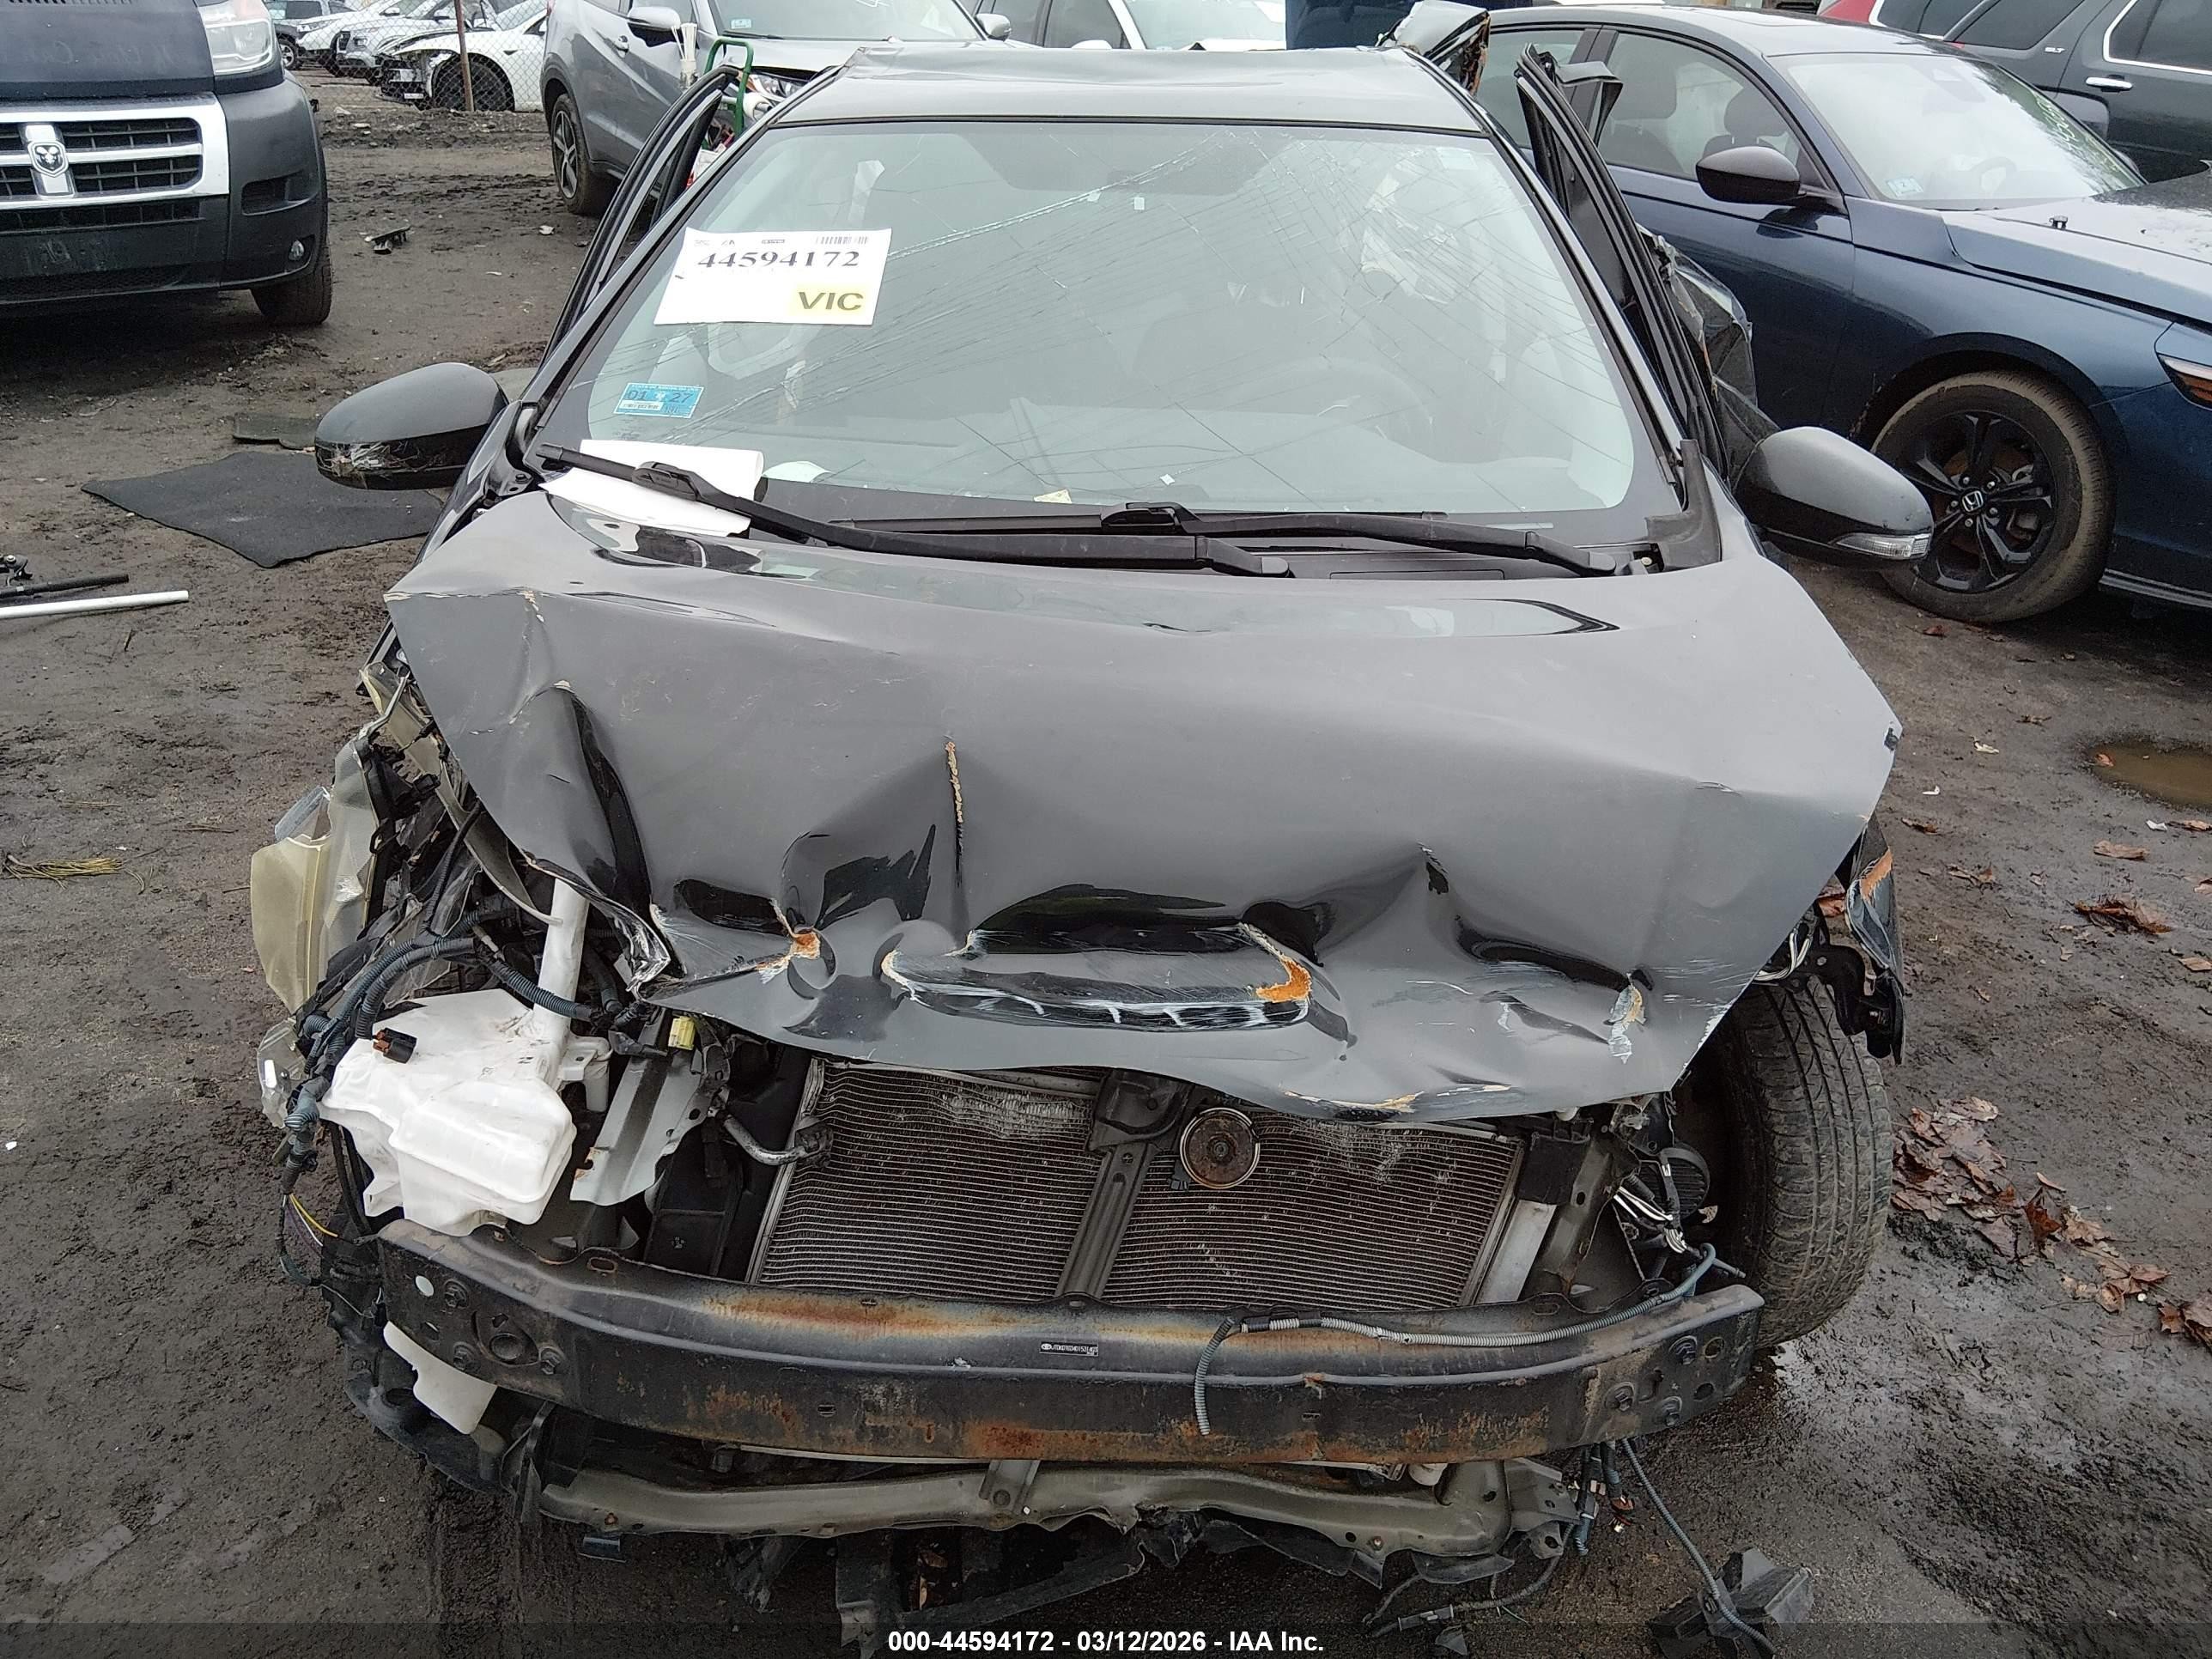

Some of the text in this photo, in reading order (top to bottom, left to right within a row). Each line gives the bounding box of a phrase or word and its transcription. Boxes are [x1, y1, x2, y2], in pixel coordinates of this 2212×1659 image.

[696, 251, 860, 268] 44594172
[798, 291, 864, 311] VIC
[627, 390, 695, 404] 01 27
